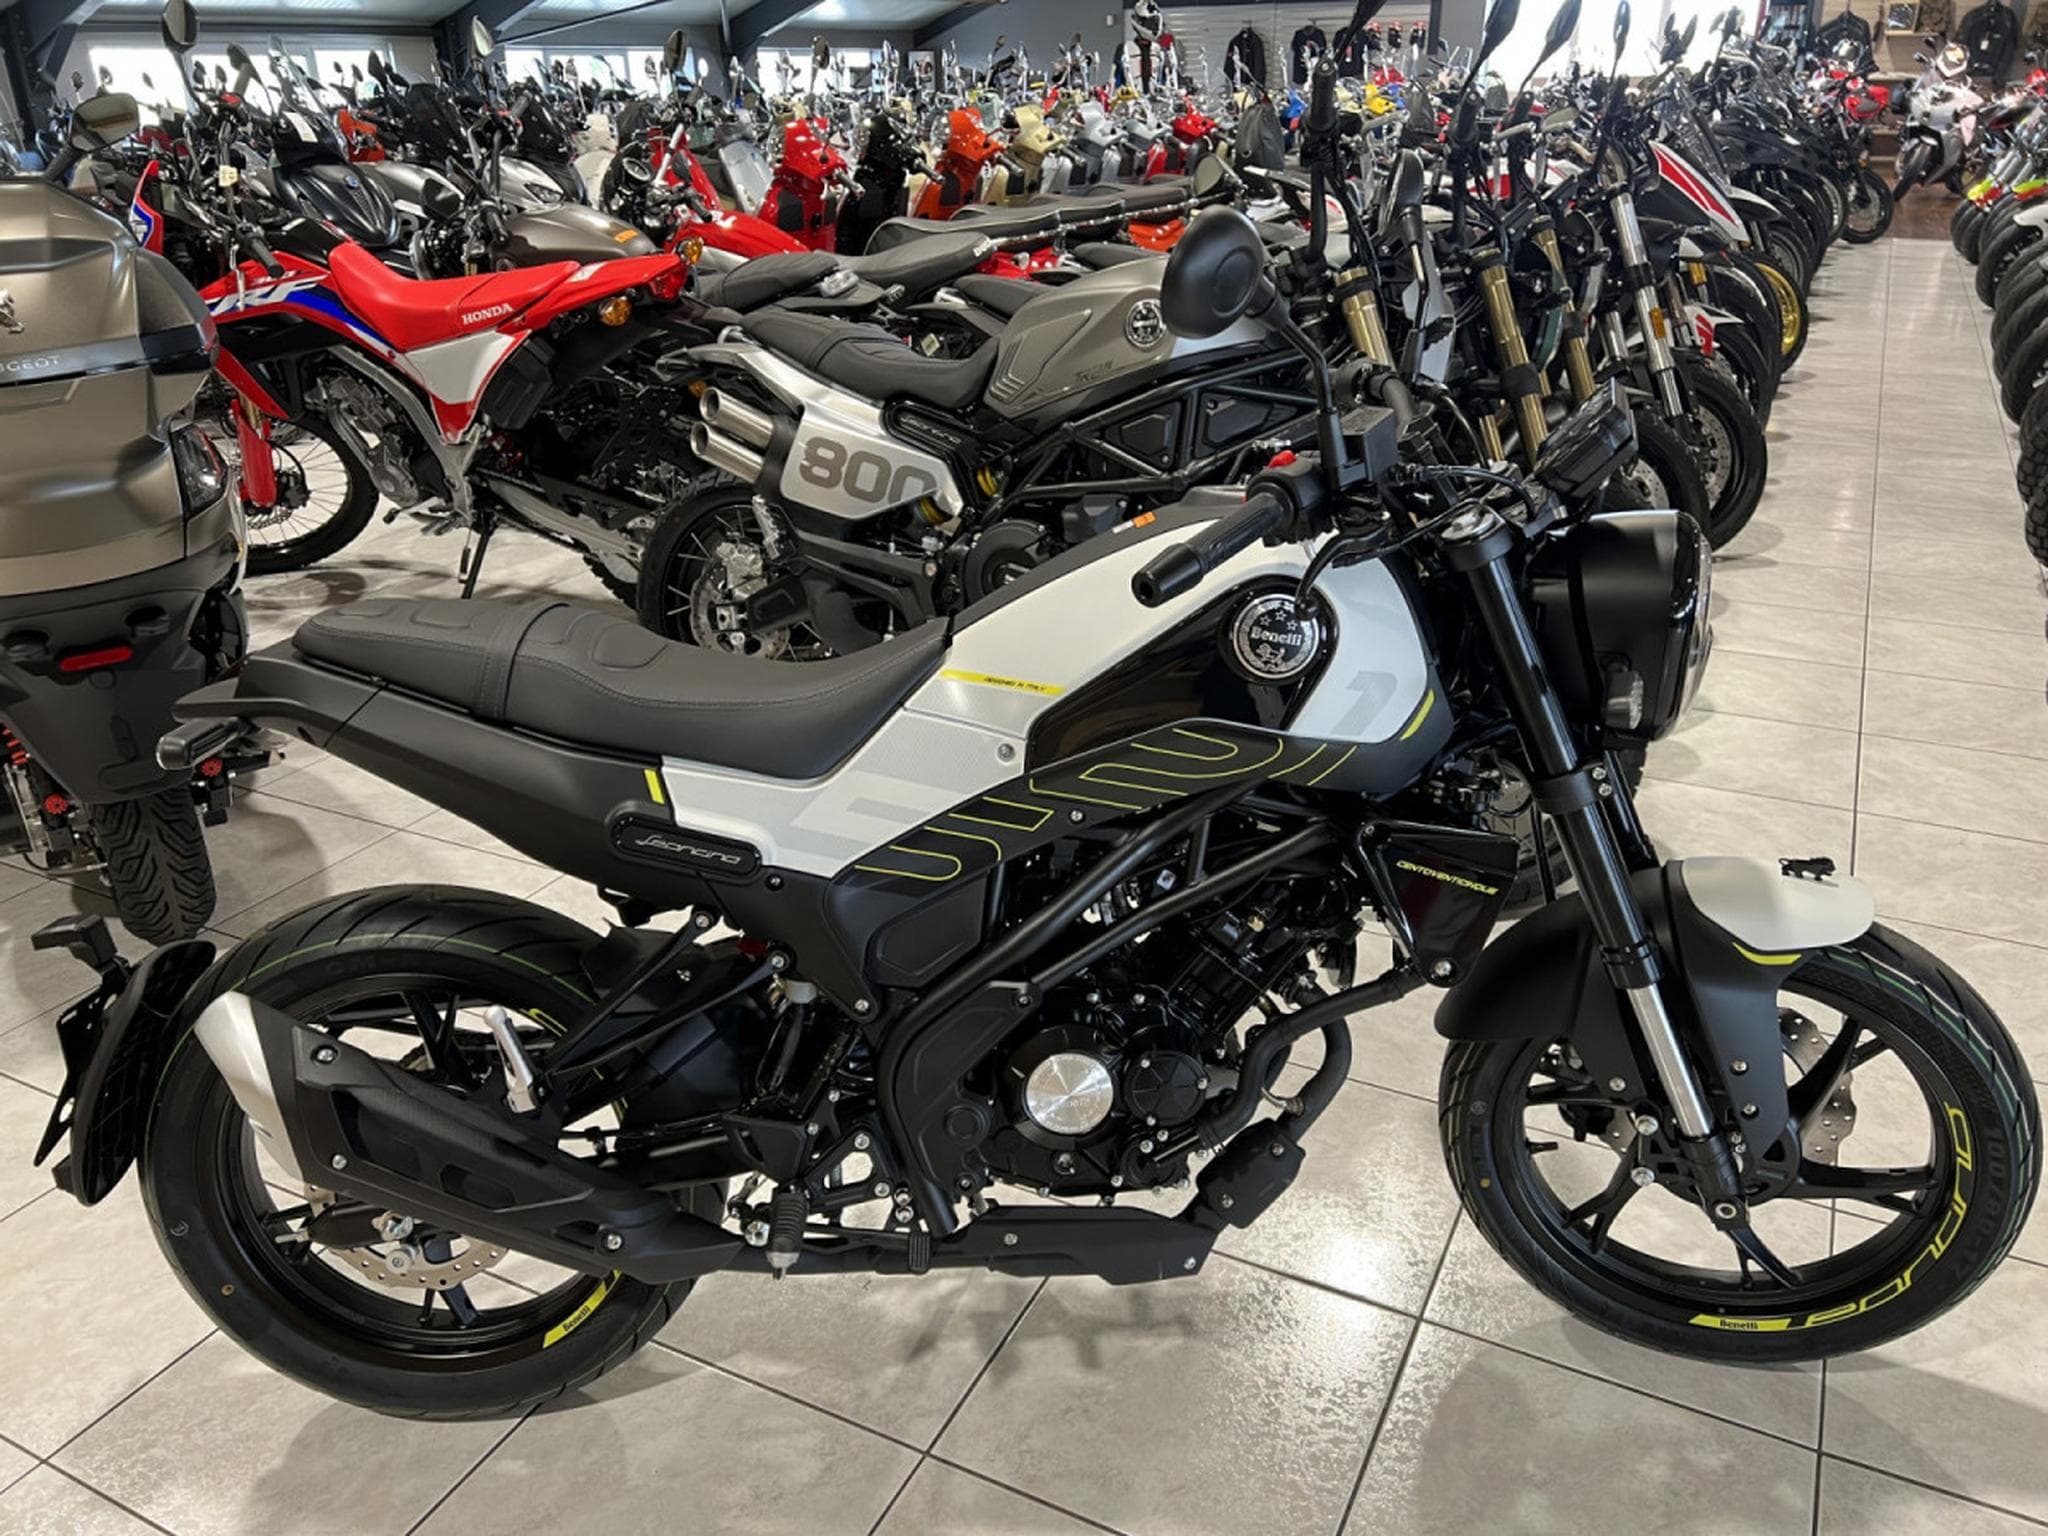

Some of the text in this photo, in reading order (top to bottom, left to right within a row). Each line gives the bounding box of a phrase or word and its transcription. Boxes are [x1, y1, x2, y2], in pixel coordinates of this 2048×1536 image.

[461, 303, 513, 325] HONDA
[799, 436, 938, 505] 800
[1250, 625, 1302, 647] Benelli
[1719, 1318, 1758, 1332] Benelli
